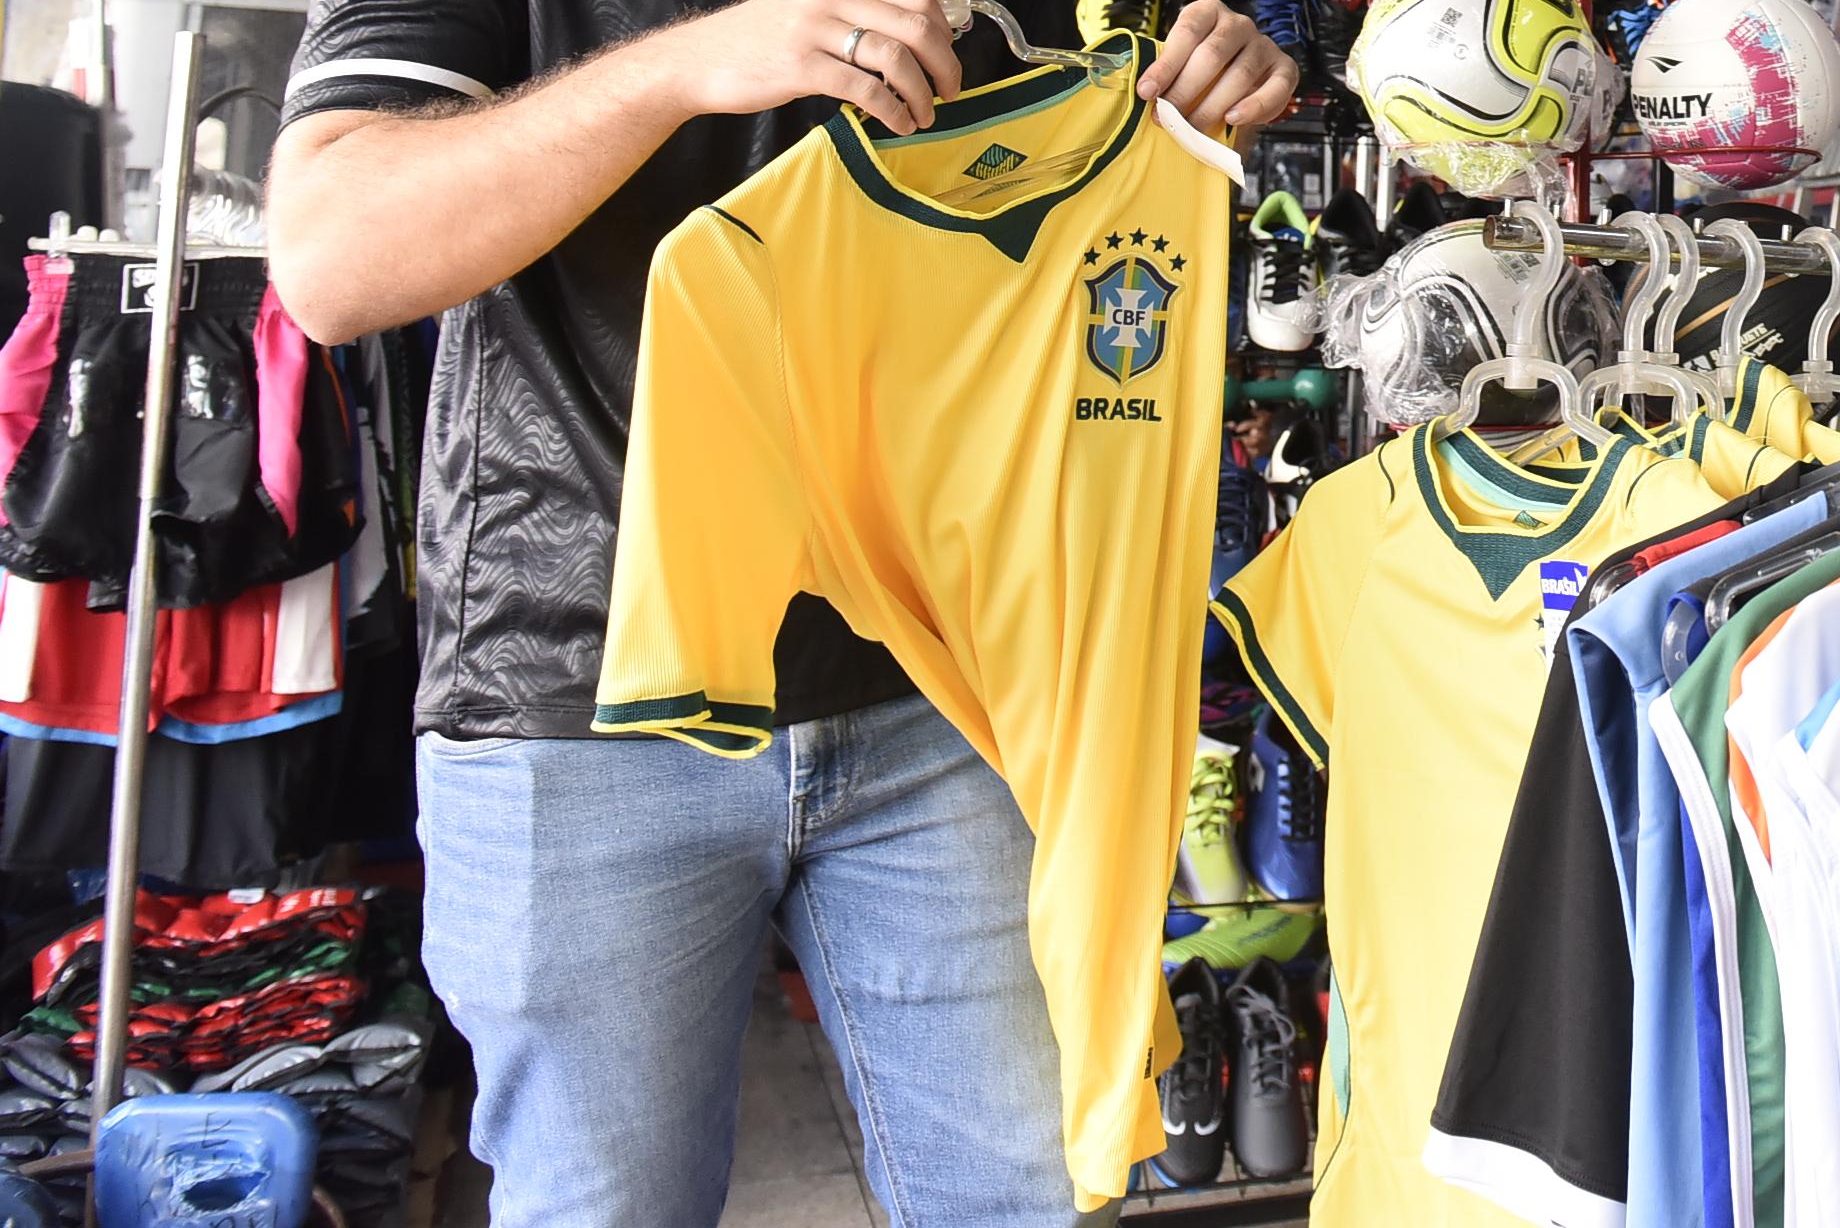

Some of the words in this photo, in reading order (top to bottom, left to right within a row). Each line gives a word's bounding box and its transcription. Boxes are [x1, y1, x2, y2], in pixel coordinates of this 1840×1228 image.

[1112, 308, 1146, 327] CBF
[1075, 397, 1162, 422] BRASIL
[1541, 576, 1580, 597] BRASIL
